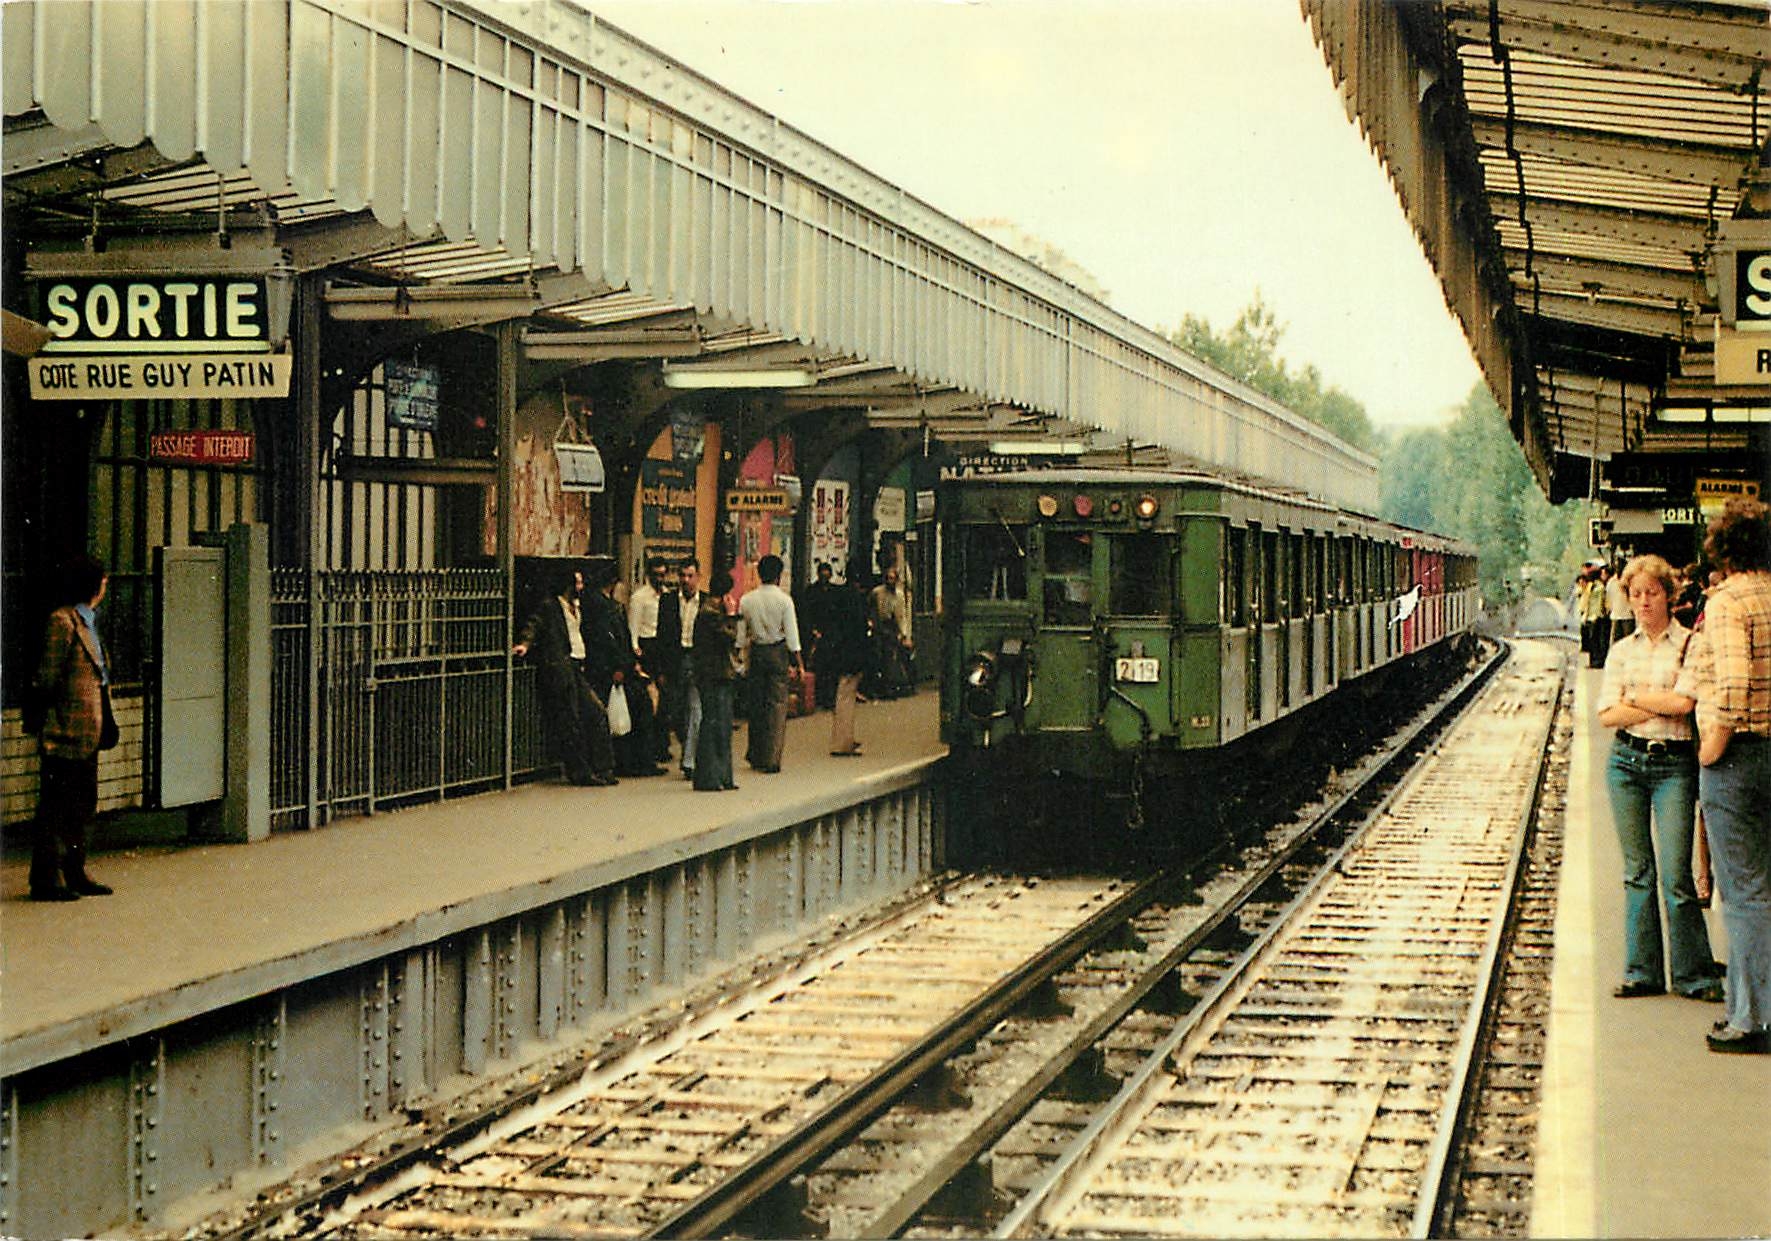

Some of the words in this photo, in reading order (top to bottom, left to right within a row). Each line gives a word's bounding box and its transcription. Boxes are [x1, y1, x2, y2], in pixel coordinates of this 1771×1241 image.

[47, 283, 261, 338] SORTIE
[40, 364, 78, 389] COTE
[87, 364, 132, 388] RUE
[143, 363, 192, 388] GUY
[203, 362, 275, 387] PATIN
[151, 435, 197, 458] PASSAGE
[203, 435, 250, 459] INTERDIT
[960, 456, 1028, 466] DIRECTION
